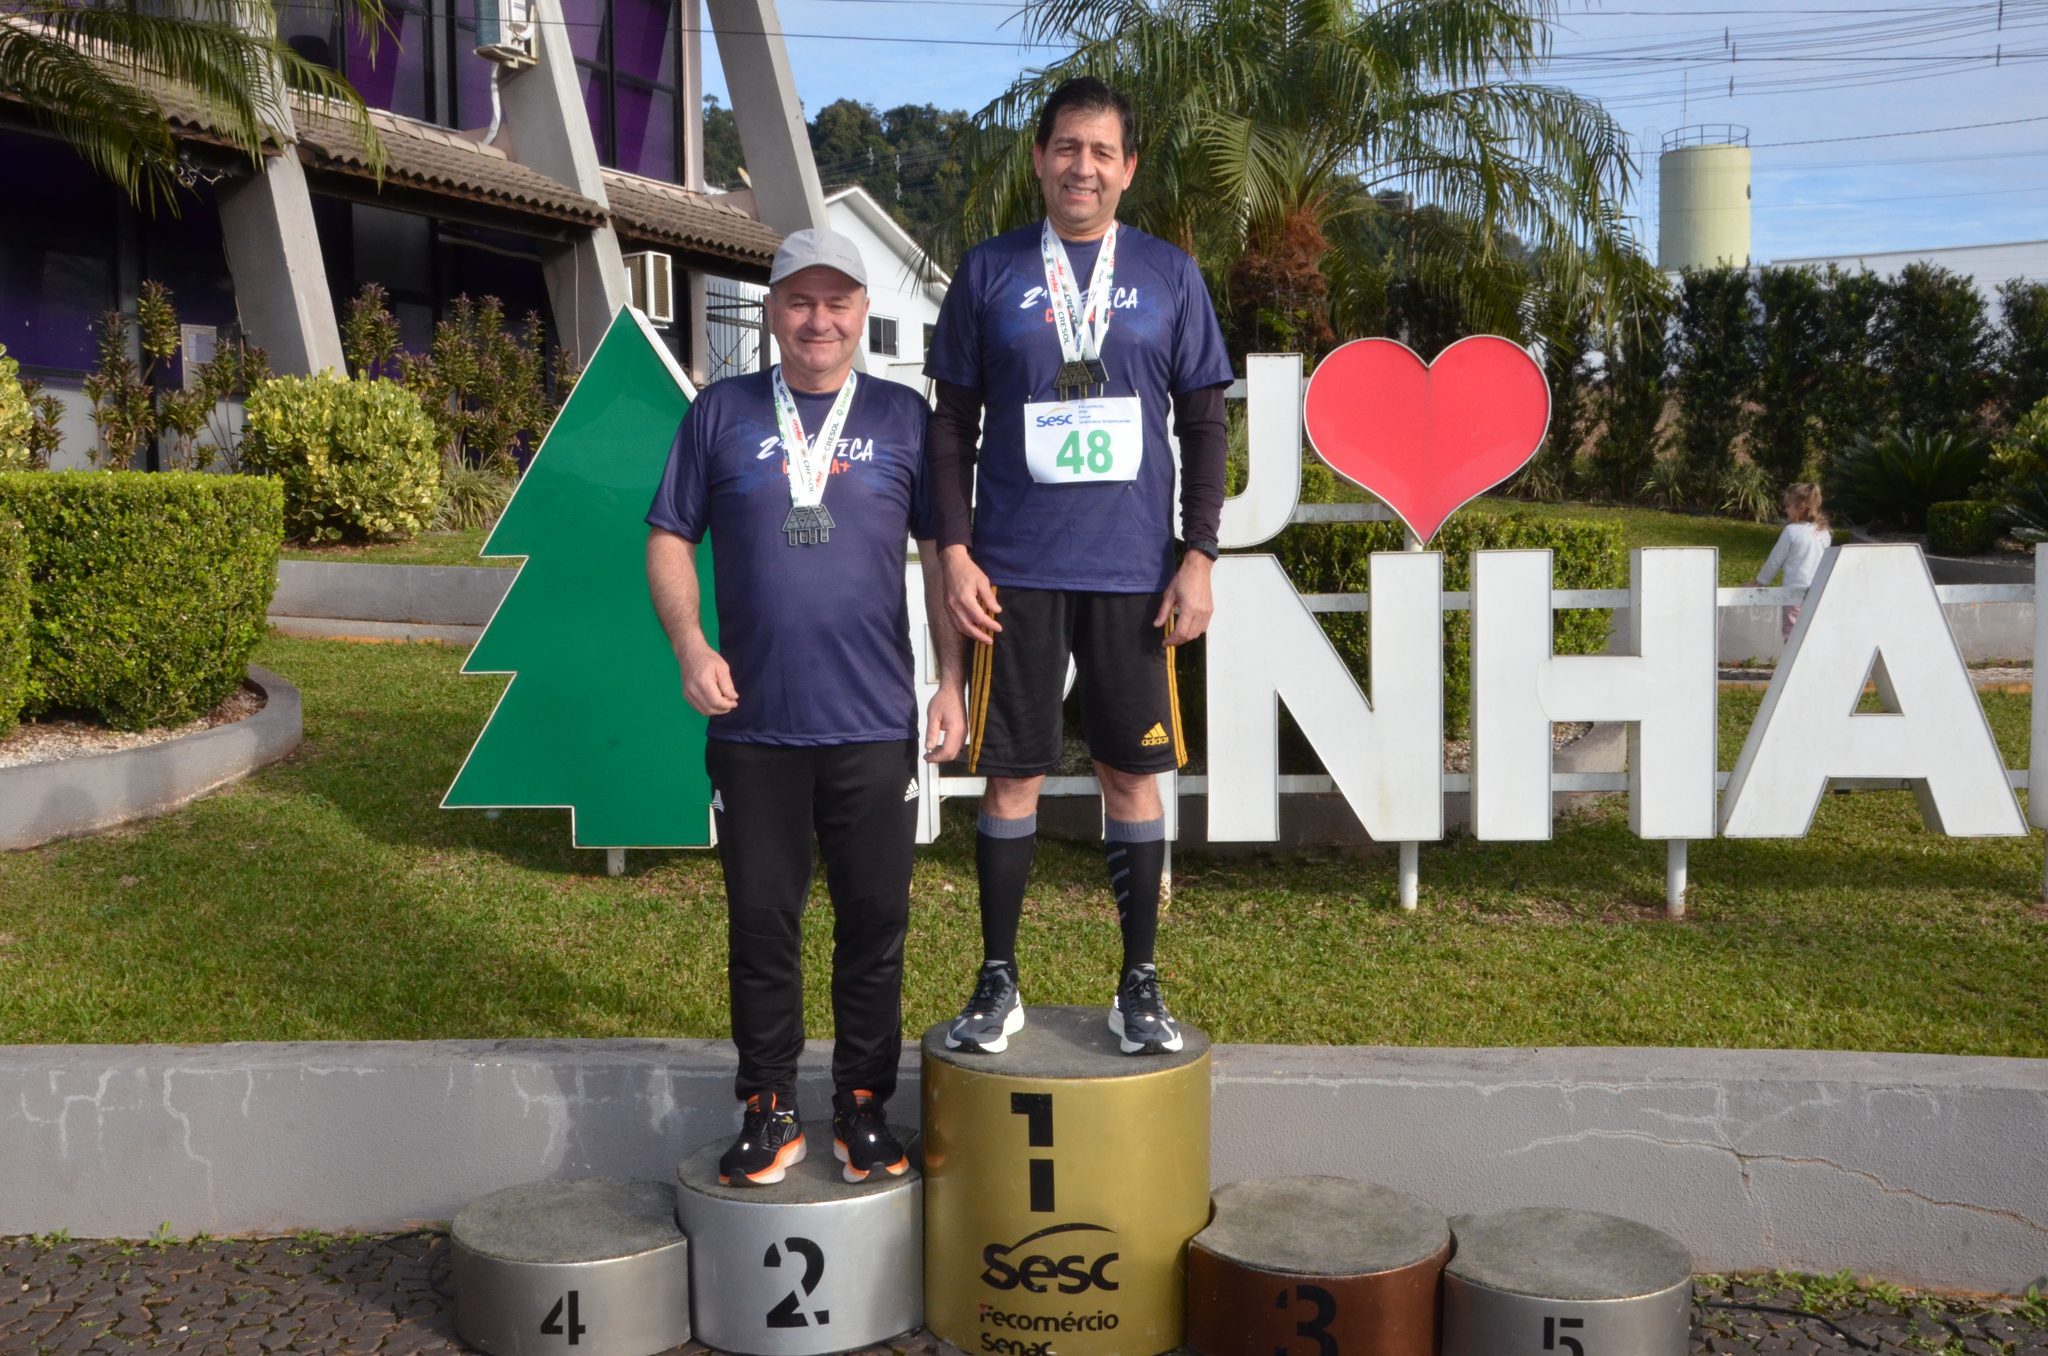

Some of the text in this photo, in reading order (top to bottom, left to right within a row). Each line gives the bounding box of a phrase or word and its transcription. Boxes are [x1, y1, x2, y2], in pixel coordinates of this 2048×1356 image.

[1057, 310, 1070, 345] CRESOL
[825, 421, 840, 452] CRESOL
[1055, 429, 1114, 475] 48
[1010, 1091, 1055, 1213] 1
[763, 1236, 830, 1329] 2
[540, 1290, 586, 1346] 4
[1274, 1284, 1340, 1356] 3
[1543, 1316, 1585, 1356] 5
